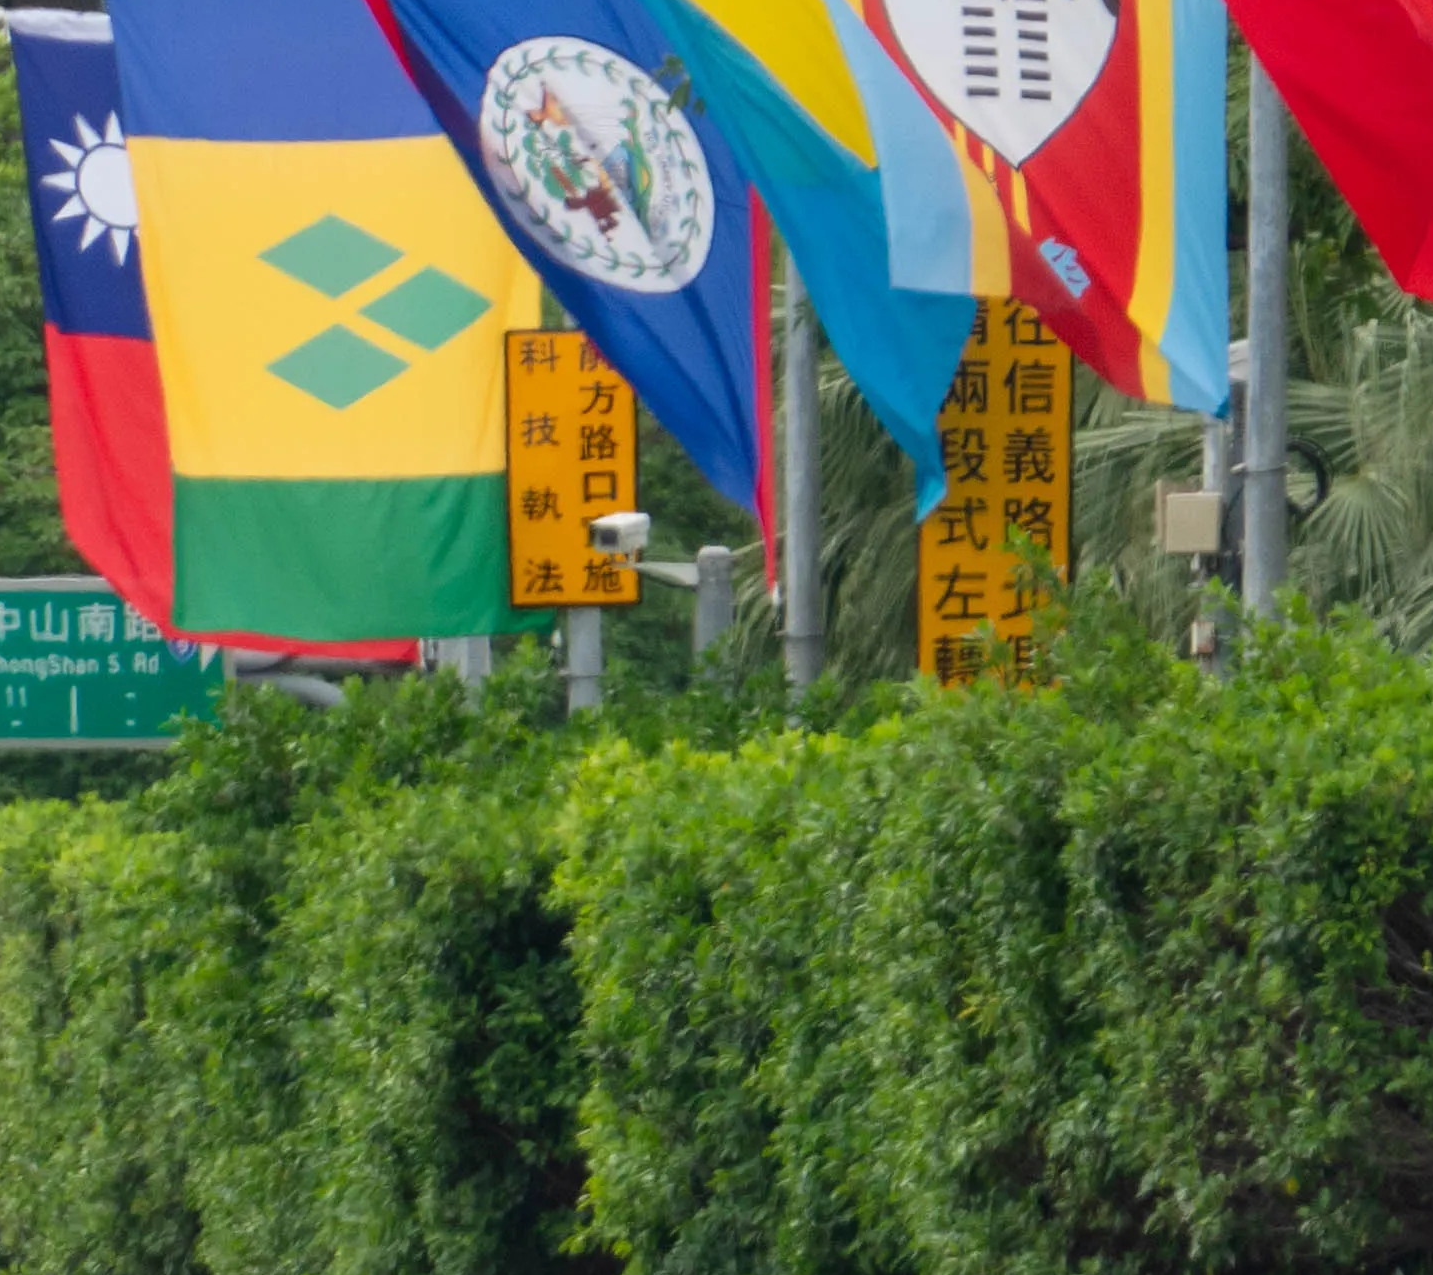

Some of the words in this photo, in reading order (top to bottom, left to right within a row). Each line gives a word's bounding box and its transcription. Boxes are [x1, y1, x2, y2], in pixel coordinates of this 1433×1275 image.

[520, 337, 564, 595] 科技執法
[578, 340, 623, 595] 方路口施
